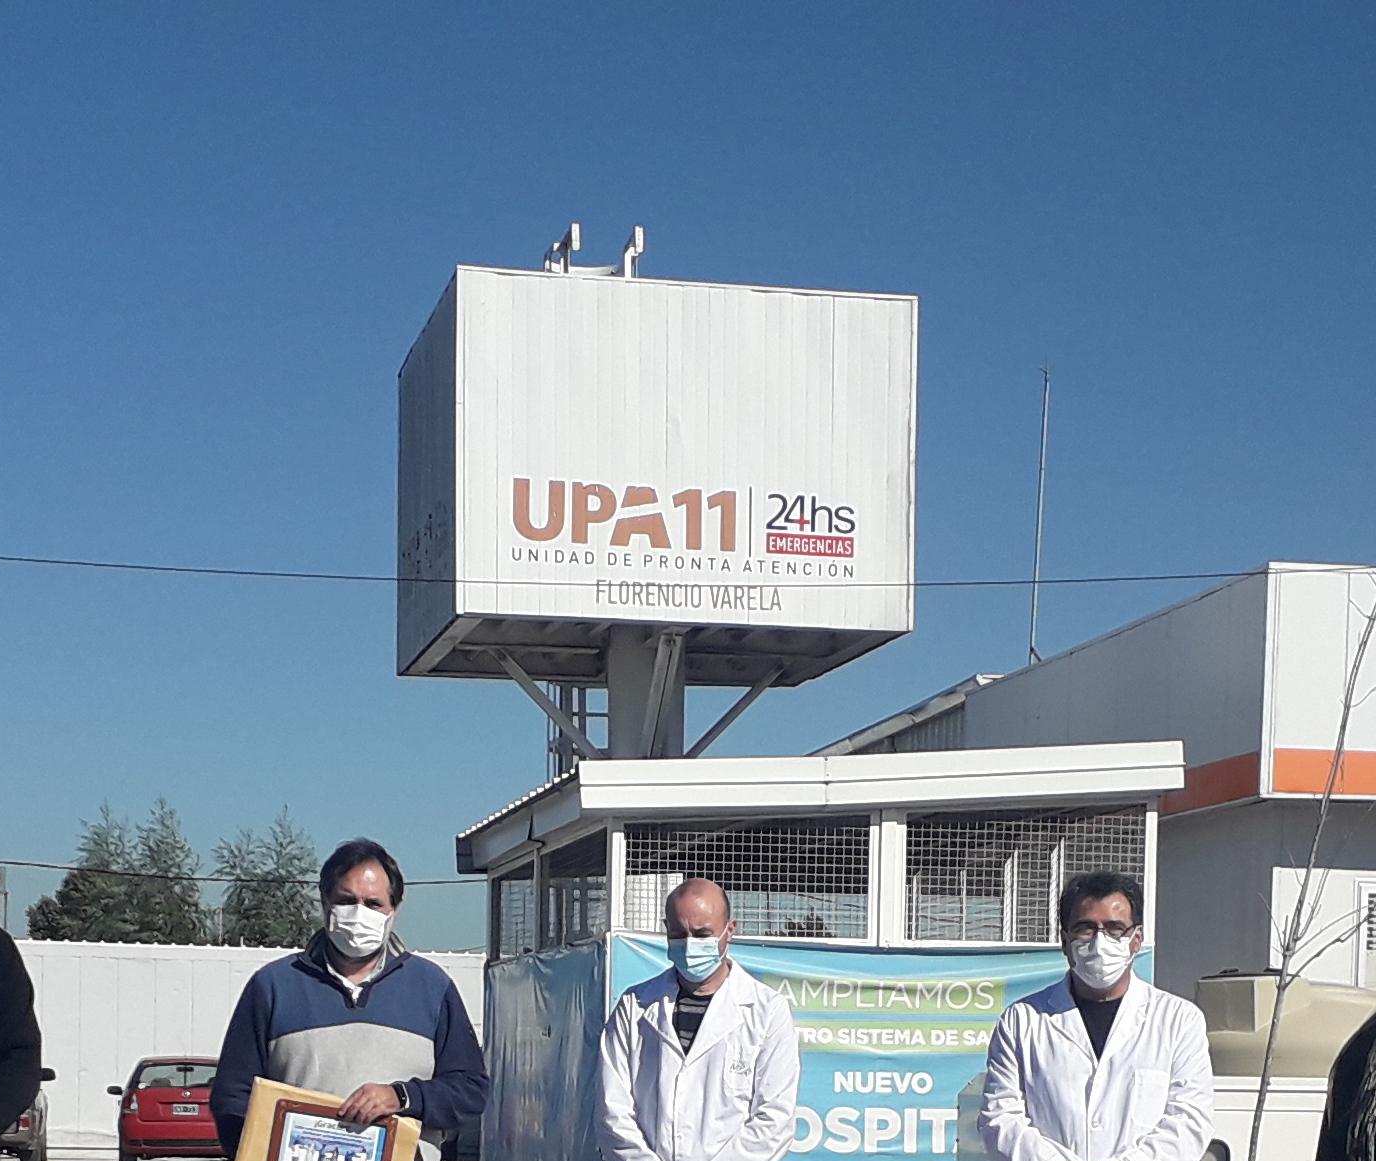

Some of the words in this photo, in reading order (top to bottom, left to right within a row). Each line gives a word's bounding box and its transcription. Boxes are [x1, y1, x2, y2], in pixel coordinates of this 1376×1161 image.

[766, 493, 856, 534] 24hs
[768, 535, 853, 555] EMERGENCIAS
[512, 547, 595, 565] UNIDAD
[607, 552, 632, 567] DE
[643, 554, 731, 572] PRONTA
[742, 558, 854, 578] ATENCIÓN
[595, 579, 702, 608] FLORENCIO
[710, 584, 782, 611] VARELA
[777, 979, 995, 1010] AMPLIAMOS
[837, 1028, 926, 1045] SISTEMA
[931, 1030, 959, 1046] DE
[834, 1071, 933, 1094] NUEVO
[788, 1107, 957, 1154] OSPIT
